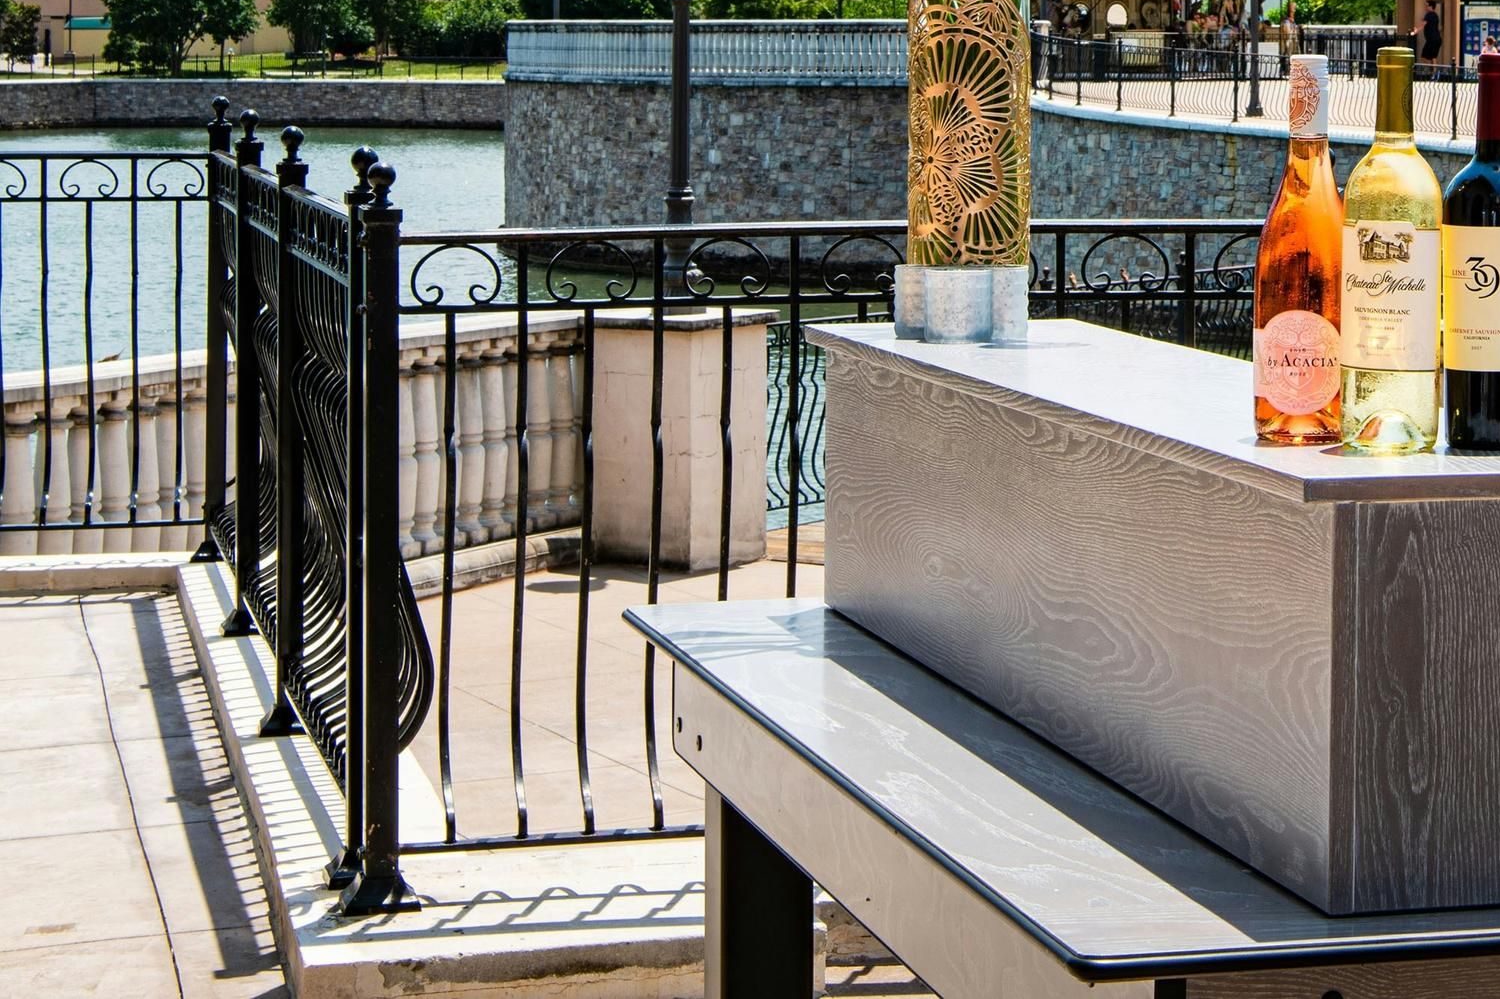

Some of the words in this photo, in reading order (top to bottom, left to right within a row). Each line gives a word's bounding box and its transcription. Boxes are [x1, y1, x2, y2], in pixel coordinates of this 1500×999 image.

[1346, 273, 1380, 292] Chateau
[1373, 270, 1393, 284] Ste
[1380, 276, 1426, 295] Michelle
[1464, 256, 1500, 299] 39
[1354, 306, 1388, 314] SAUVIGNON
[1267, 357, 1277, 369] by
[1281, 354, 1334, 368] ACACIA
